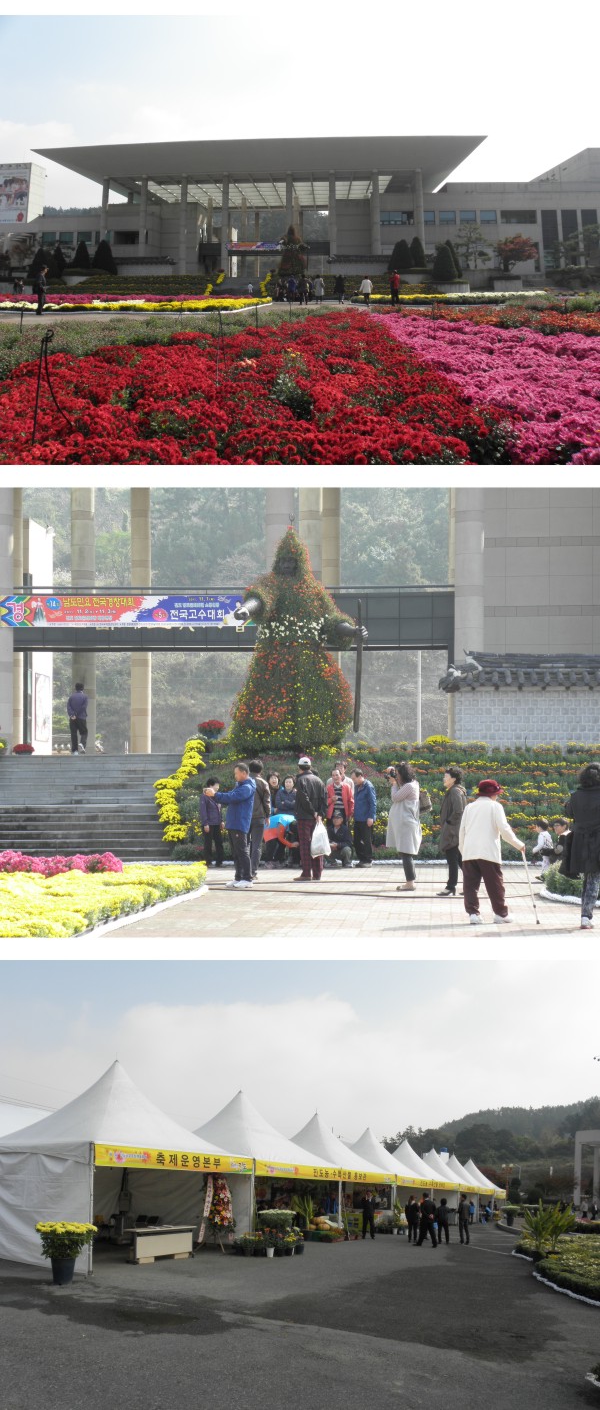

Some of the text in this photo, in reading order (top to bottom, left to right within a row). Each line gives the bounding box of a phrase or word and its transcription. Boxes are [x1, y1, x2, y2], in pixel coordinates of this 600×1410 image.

[62, 597, 91, 608] 남도민요
[169, 609, 225, 620] 전국고수대회
[156, 1151, 222, 1170] 축제운영본부
